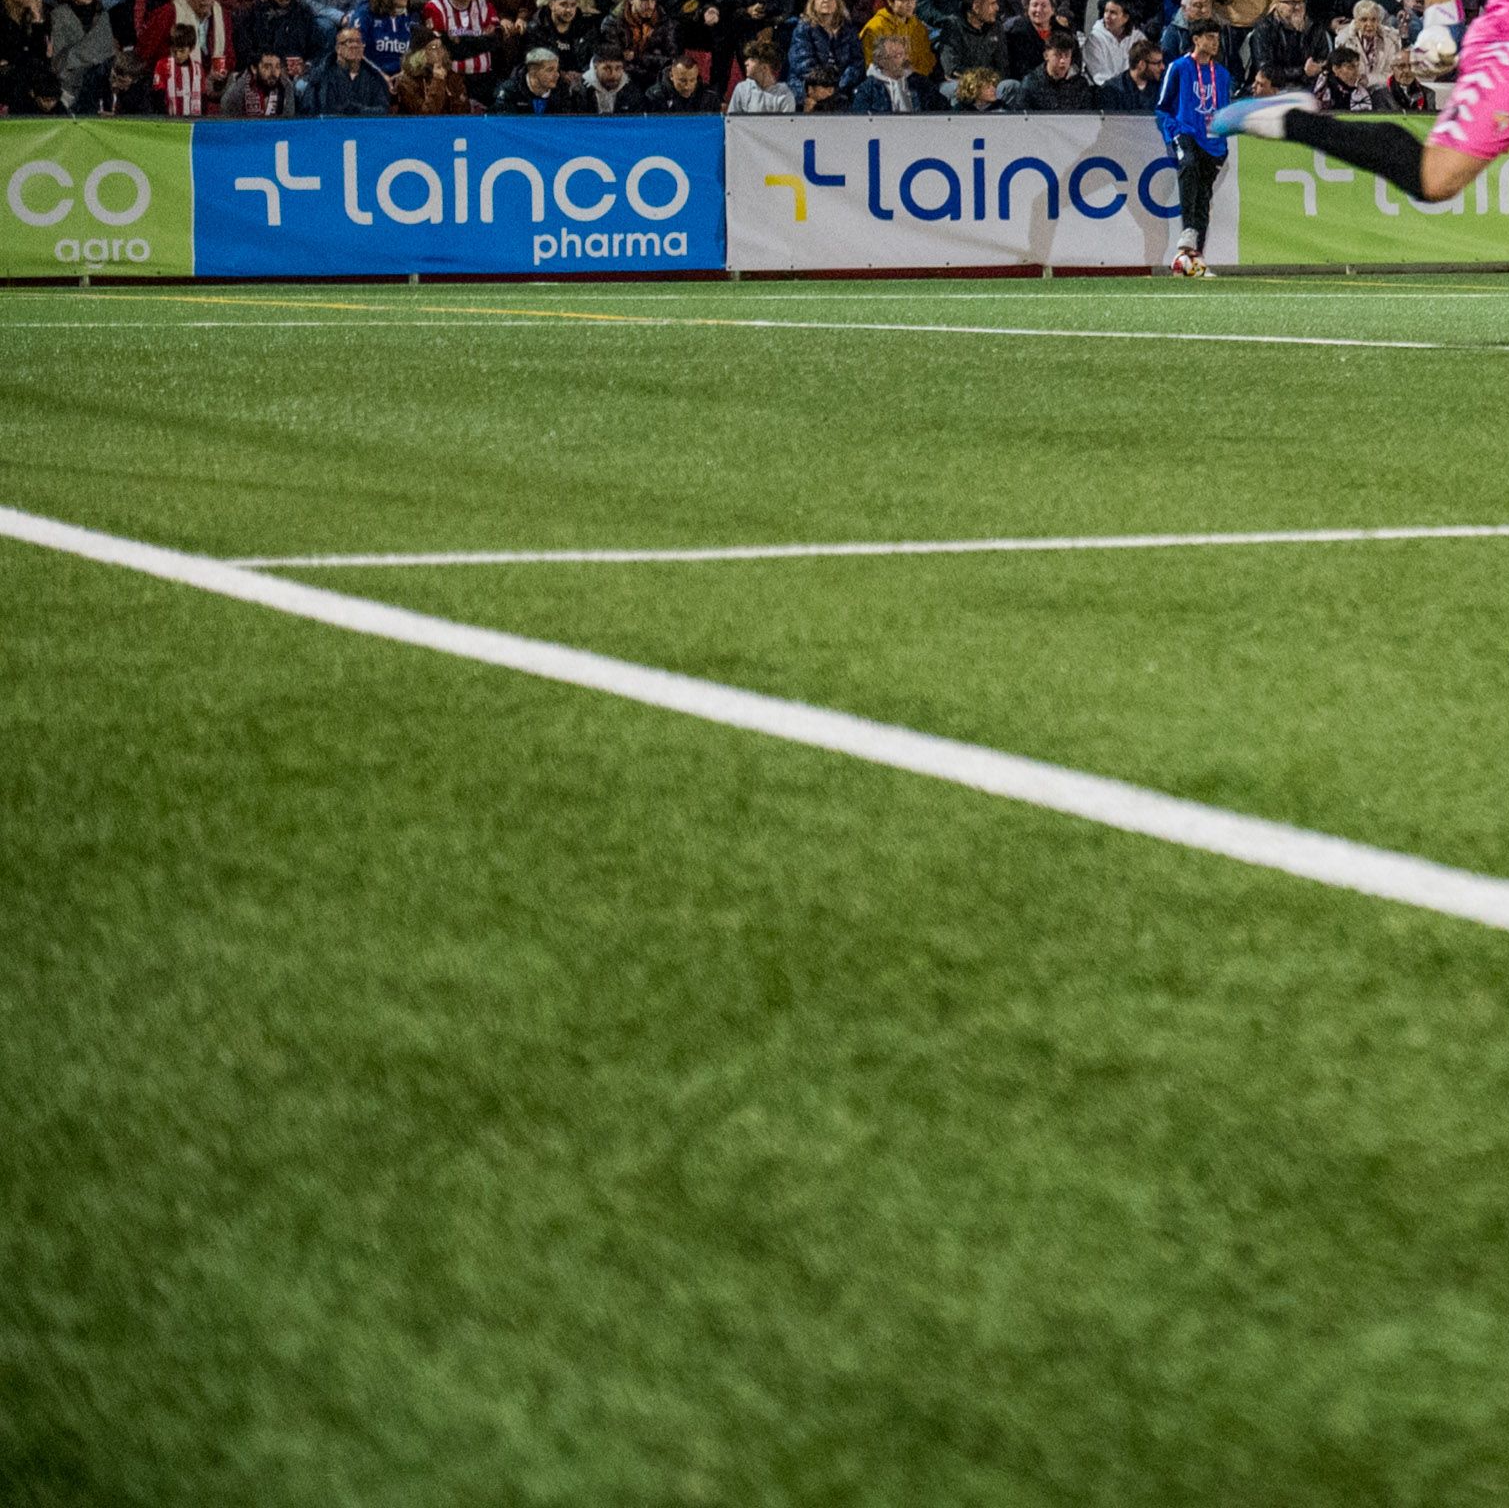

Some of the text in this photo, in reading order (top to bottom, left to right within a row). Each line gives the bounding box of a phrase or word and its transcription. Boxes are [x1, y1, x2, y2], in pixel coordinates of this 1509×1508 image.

[343, 138, 690, 225] lainco
[55, 238, 151, 269] agro
[533, 227, 688, 266] pharma
